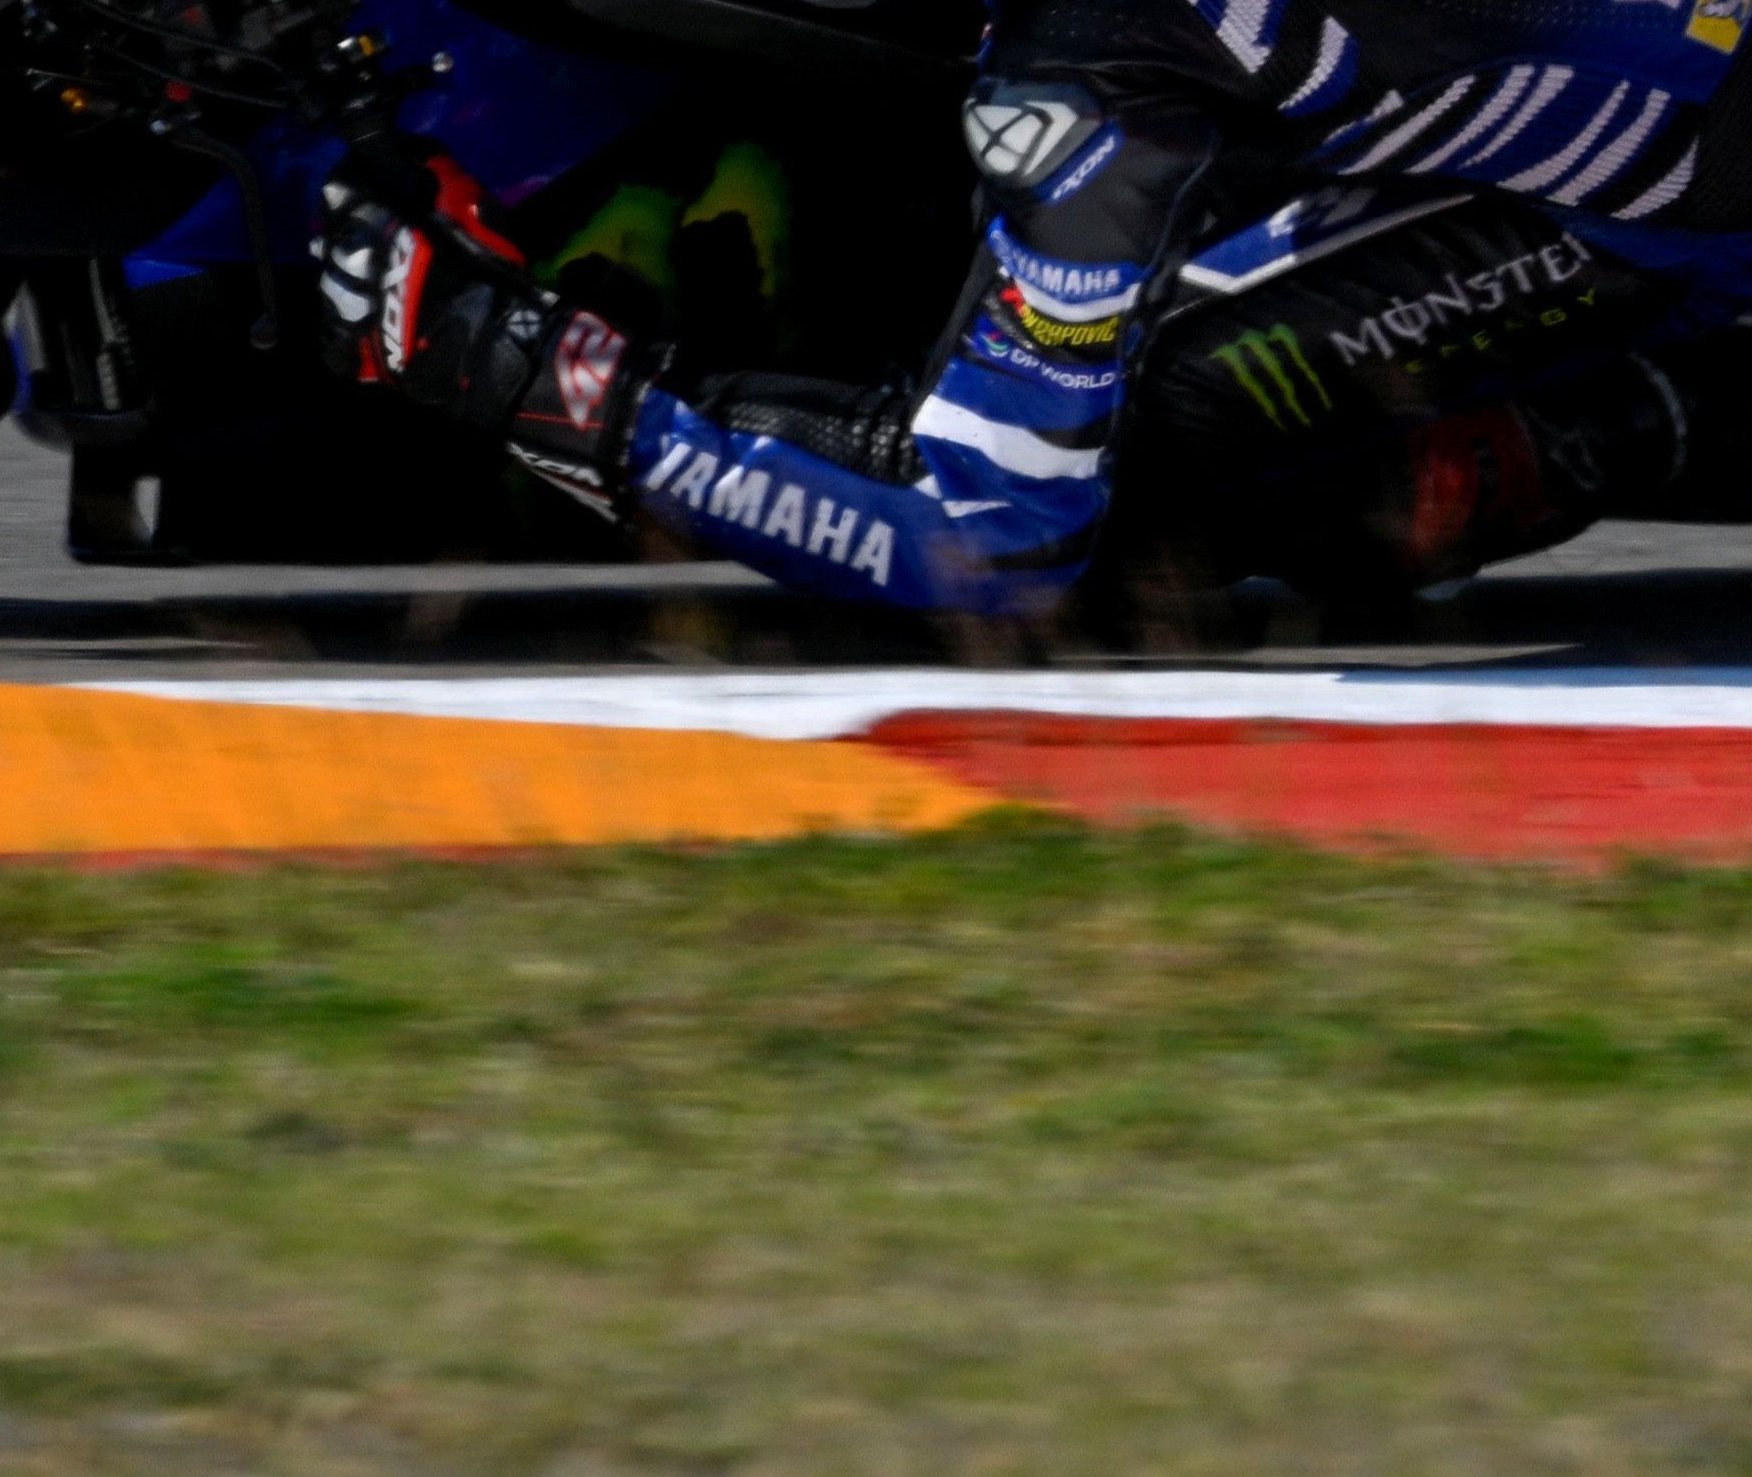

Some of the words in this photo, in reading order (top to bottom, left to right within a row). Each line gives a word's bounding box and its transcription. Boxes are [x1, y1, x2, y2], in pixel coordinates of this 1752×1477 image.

[1010, 252, 1122, 297] YAMAHA
[1040, 363, 1118, 390] WORLD
[643, 433, 897, 588] YAMAHA
